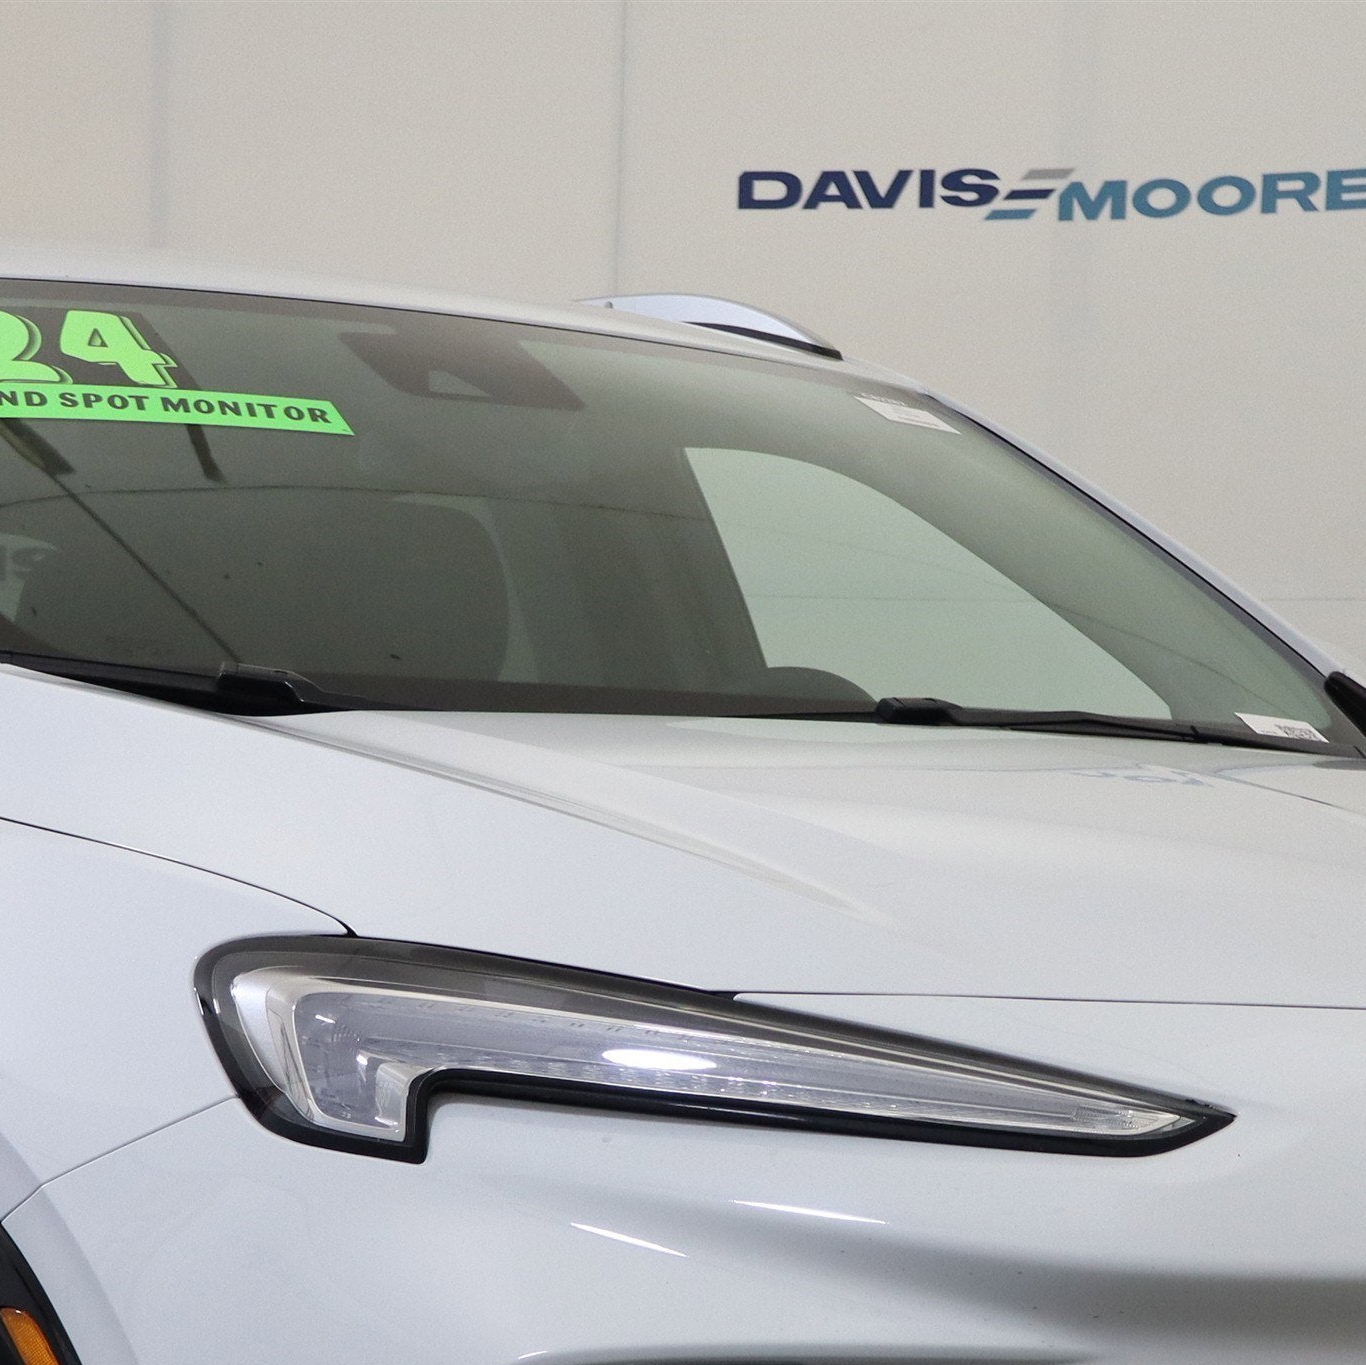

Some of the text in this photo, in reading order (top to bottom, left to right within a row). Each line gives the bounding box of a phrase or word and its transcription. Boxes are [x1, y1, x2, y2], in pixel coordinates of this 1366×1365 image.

[737, 168, 1001, 210] DAVIS
[59, 391, 150, 412] SPOT
[162, 396, 333, 425] MONITOR
